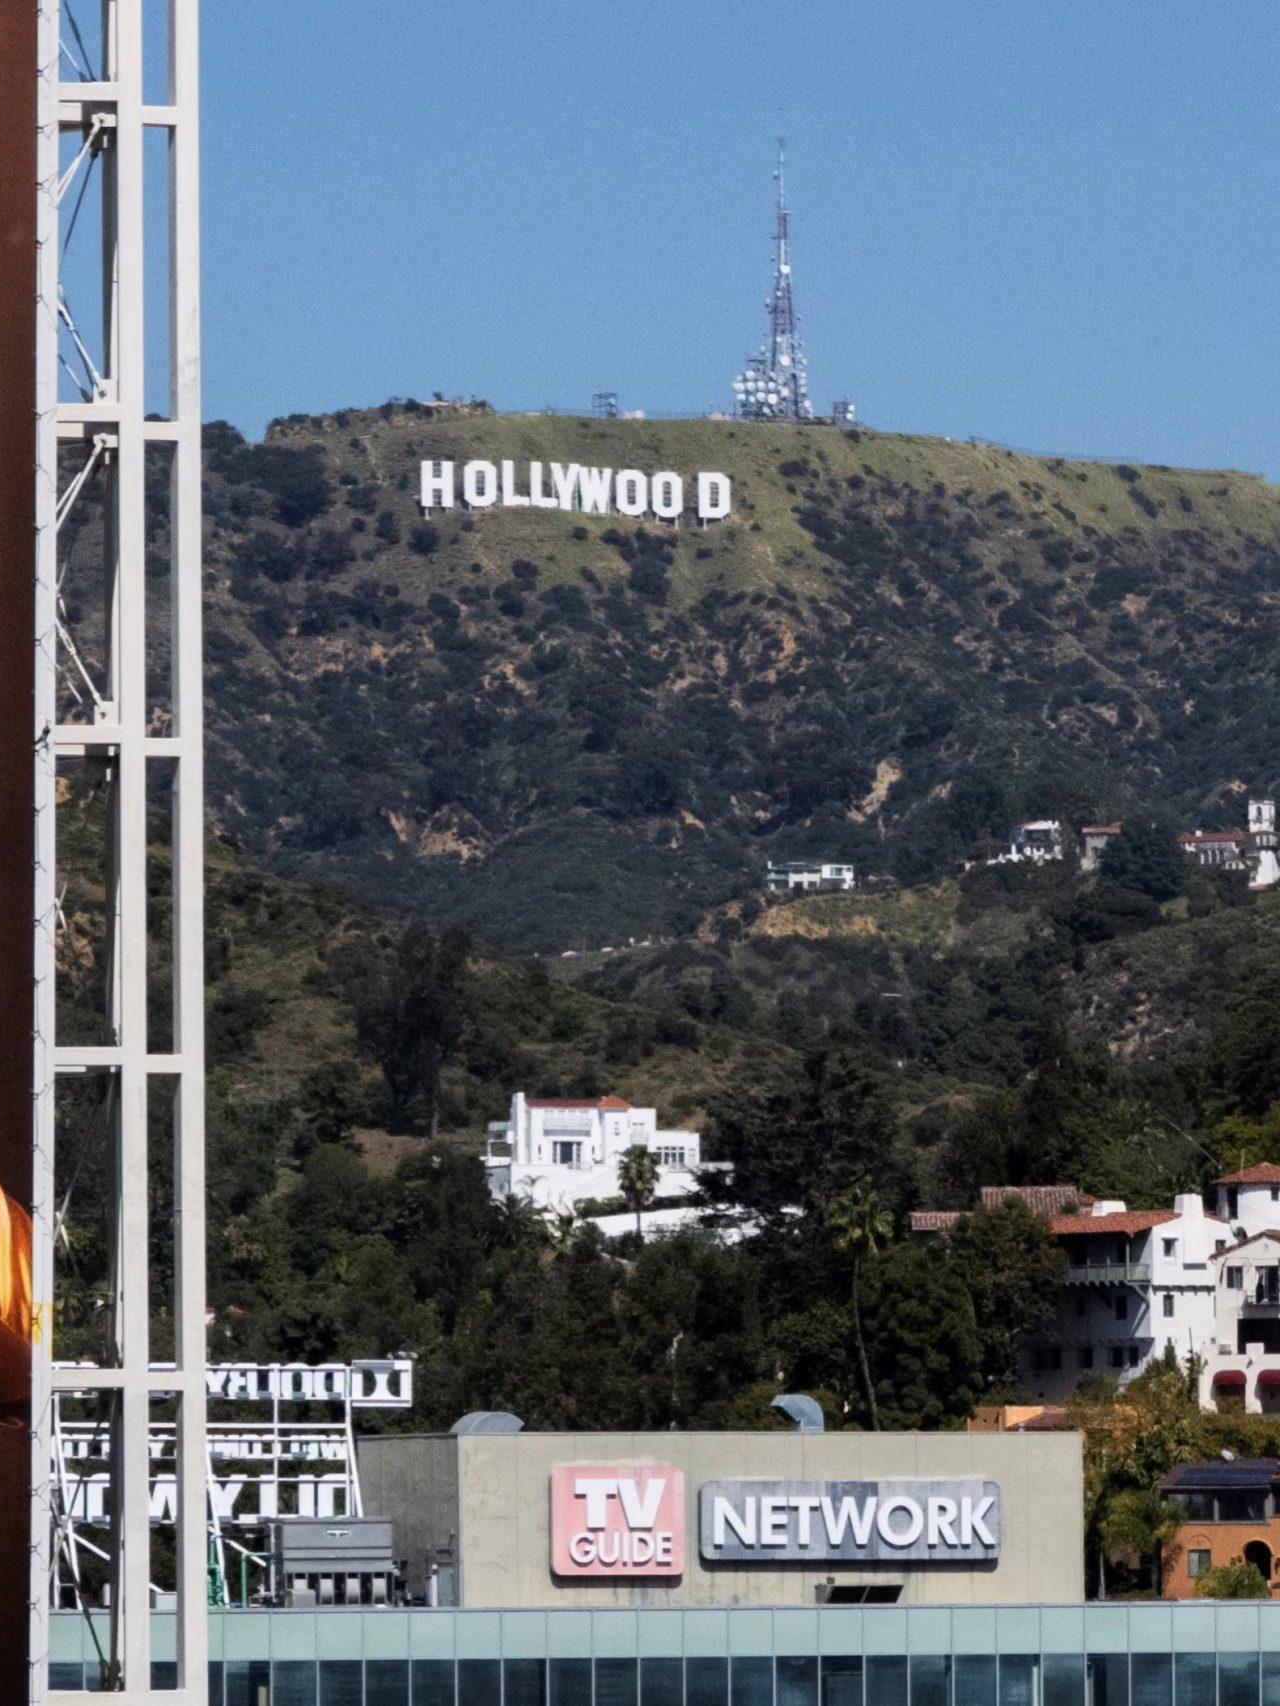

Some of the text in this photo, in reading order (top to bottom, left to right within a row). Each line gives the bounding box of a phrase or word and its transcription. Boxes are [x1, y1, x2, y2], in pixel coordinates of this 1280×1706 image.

[420, 460, 731, 519] HOLLYWOOD
[574, 1478, 666, 1528] TV
[713, 1496, 995, 1548] NETWORK
[569, 1531, 673, 1566] GUIDE
